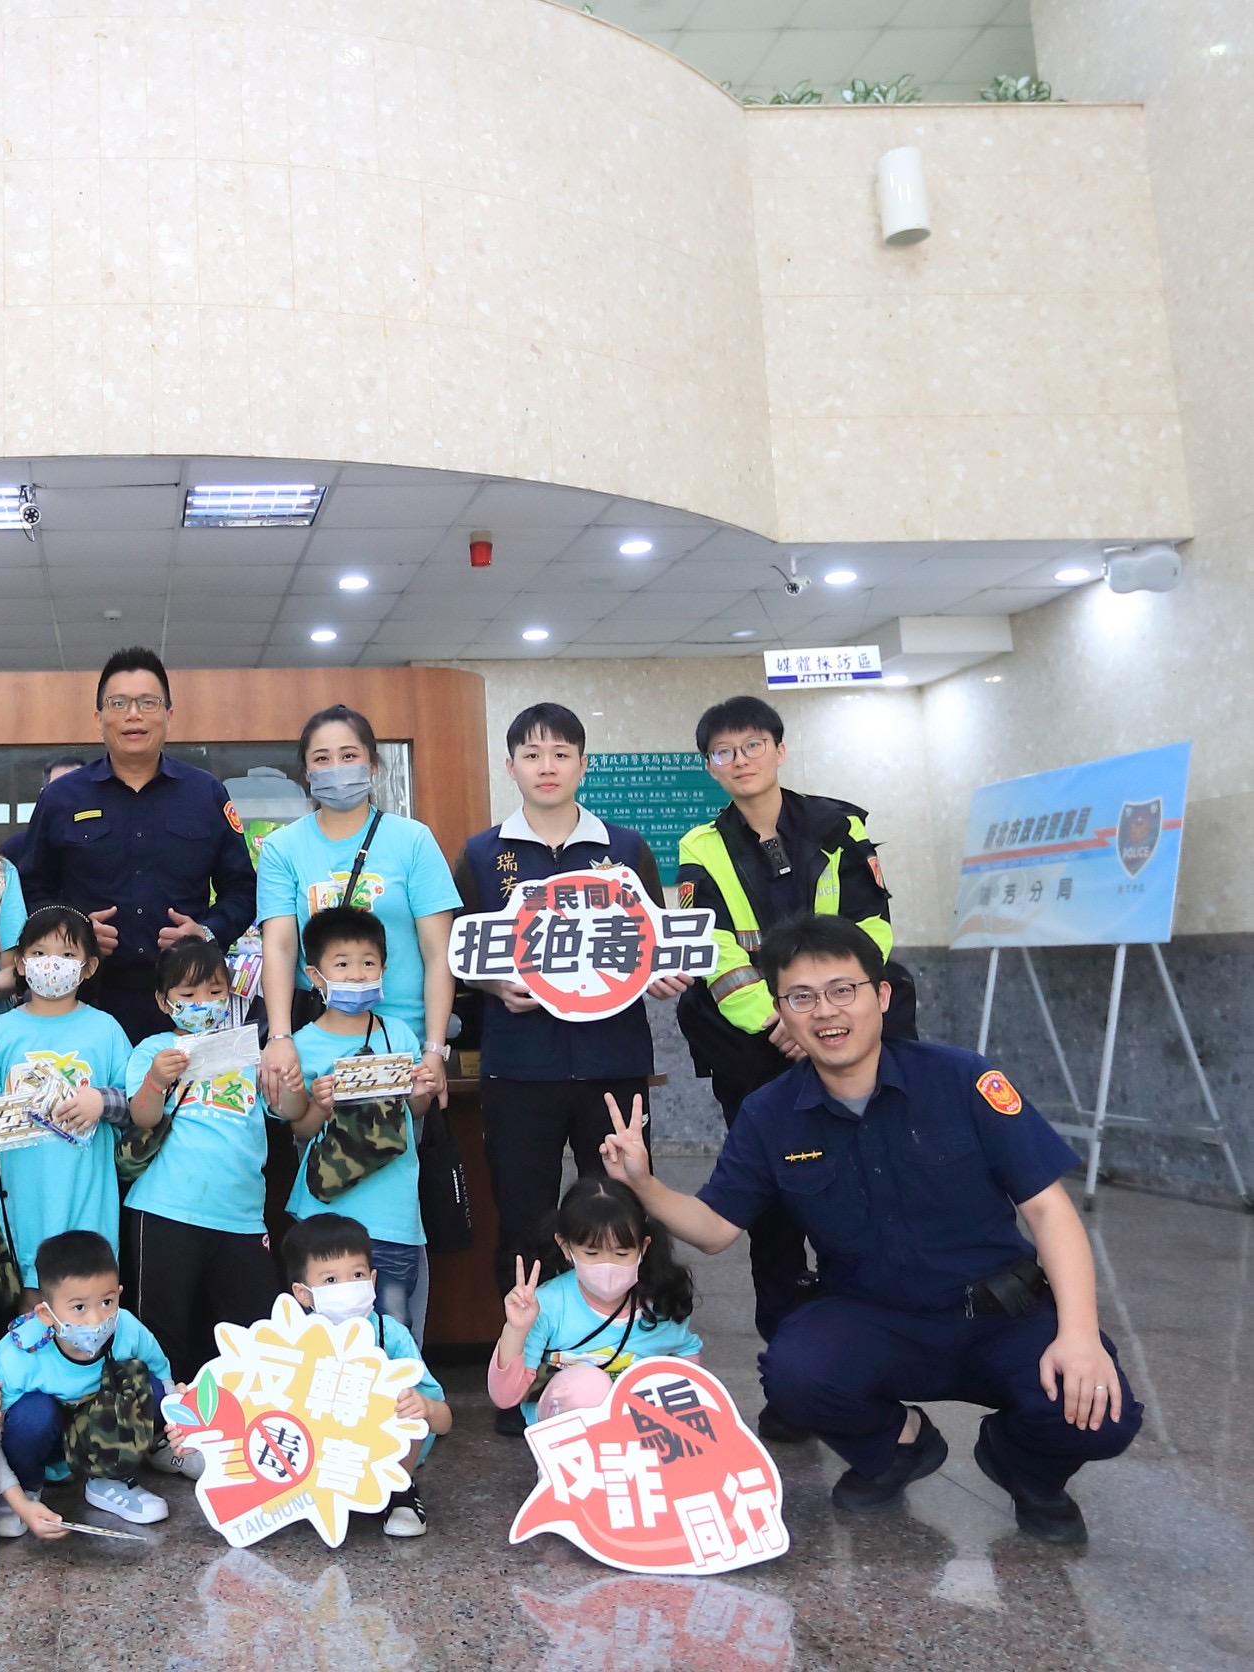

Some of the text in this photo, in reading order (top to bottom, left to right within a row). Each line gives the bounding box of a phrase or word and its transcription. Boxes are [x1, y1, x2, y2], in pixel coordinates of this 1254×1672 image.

[777, 653, 872, 673] 媒體採訪區
[797, 672, 853, 683] Press Area
[588, 753, 703, 767] 北市政府警察局瑞芳分局
[522, 883, 642, 912] 警民同心
[232, 1488, 316, 1542] TAICHUNG
[673, 1467, 786, 1568] 同行
